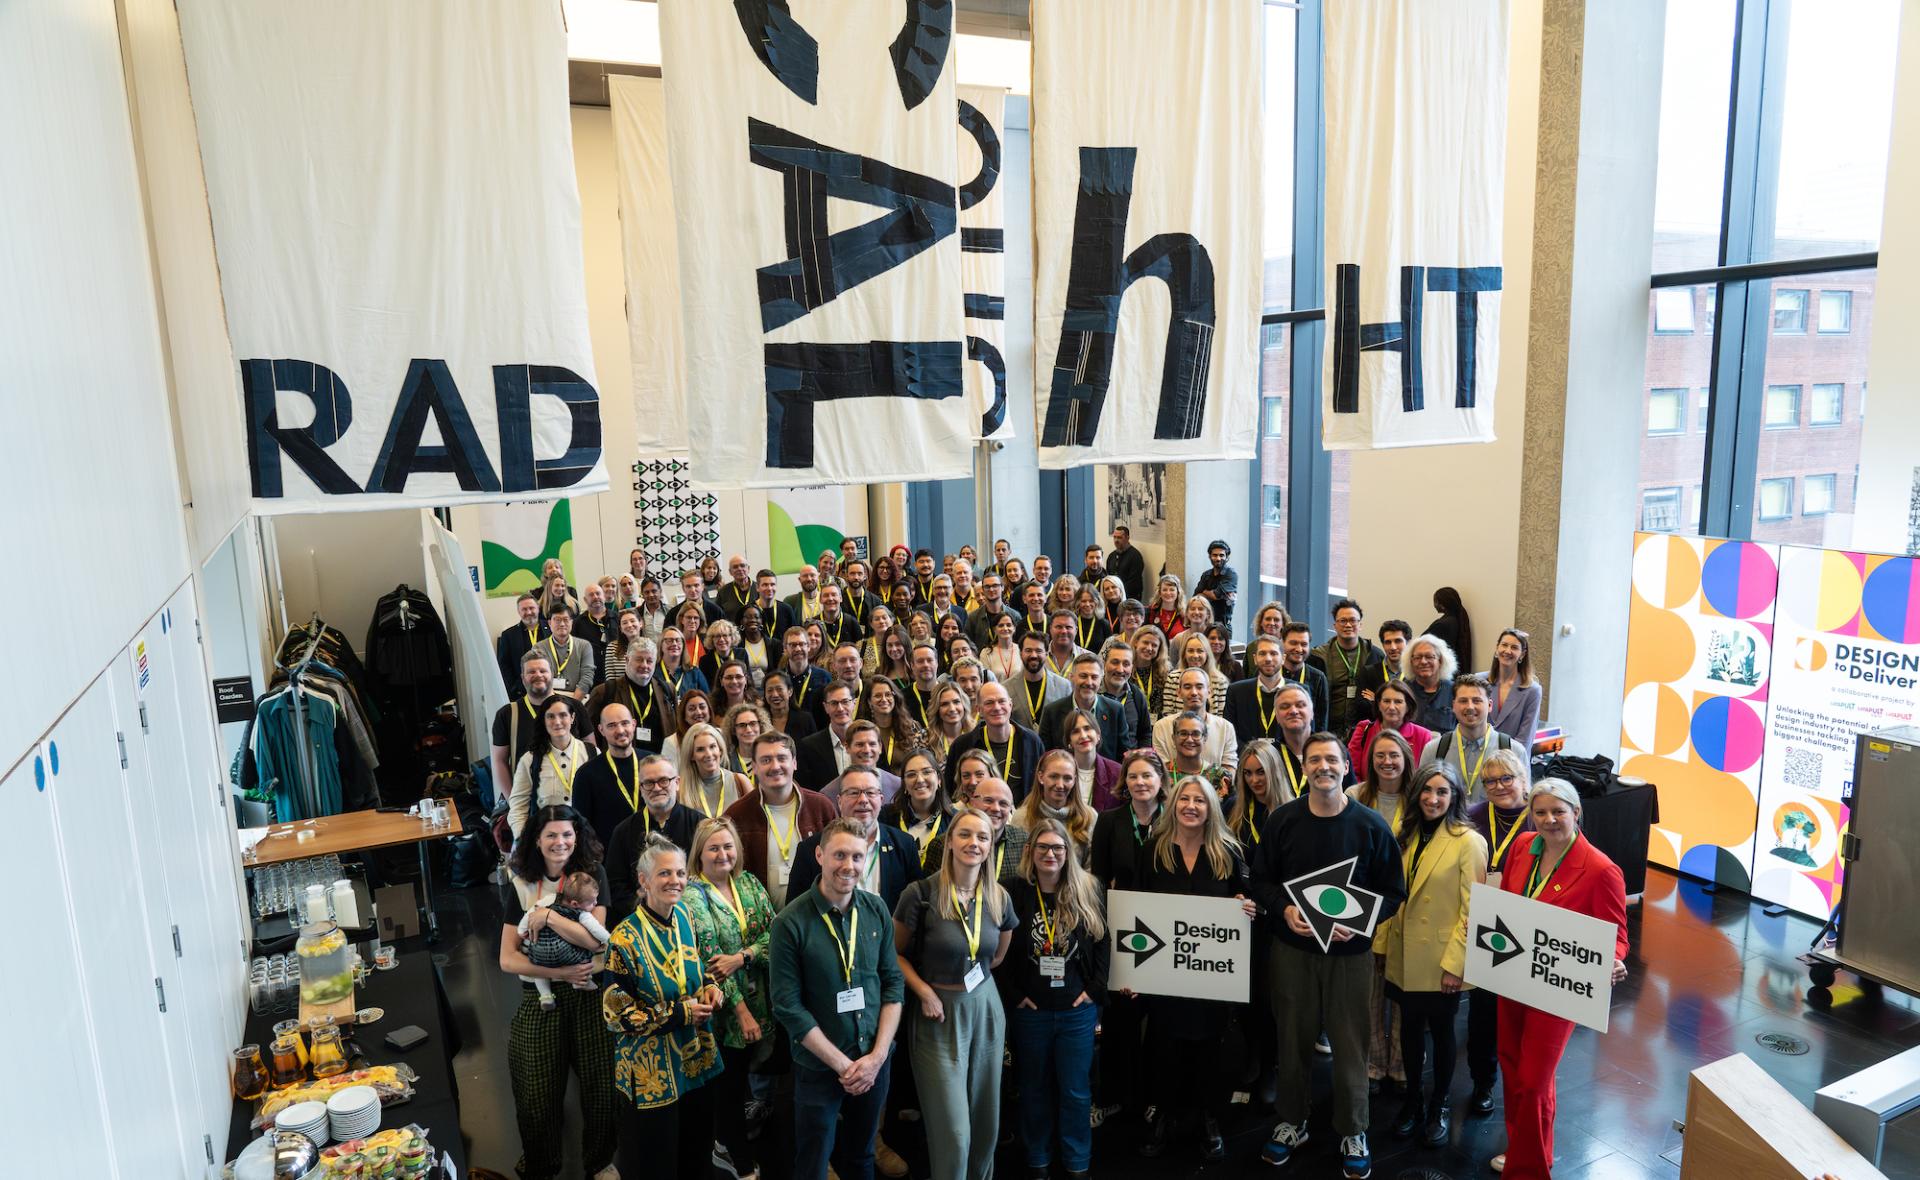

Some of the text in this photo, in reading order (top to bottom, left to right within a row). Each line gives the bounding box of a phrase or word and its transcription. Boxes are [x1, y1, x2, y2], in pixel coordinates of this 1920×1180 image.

[1333, 264, 1502, 413] HT
[240, 358, 602, 497] RAD
[1836, 644, 1920, 672] DESIGN
[1835, 662, 1918, 689] to Deliver
[1881, 696, 1905, 704] project
[1775, 713, 1800, 724] design
[1802, 720, 1835, 732] industry
[1837, 726, 1846, 734] to
[1776, 704, 1814, 719] Unlocking
[1816, 713, 1829, 722] the
[1831, 717, 1869, 729] potential
[1773, 729, 1802, 740] biggest
[1804, 736, 1848, 752] challenges.
[1774, 720, 1849, 744] businesses tackling
[1174, 920, 1240, 943] Design
[1173, 937, 1200, 954] for
[1532, 946, 1560, 968] for
[1533, 928, 1602, 966] Design
[1174, 953, 1235, 974] Planet
[1530, 962, 1594, 999] Planet
